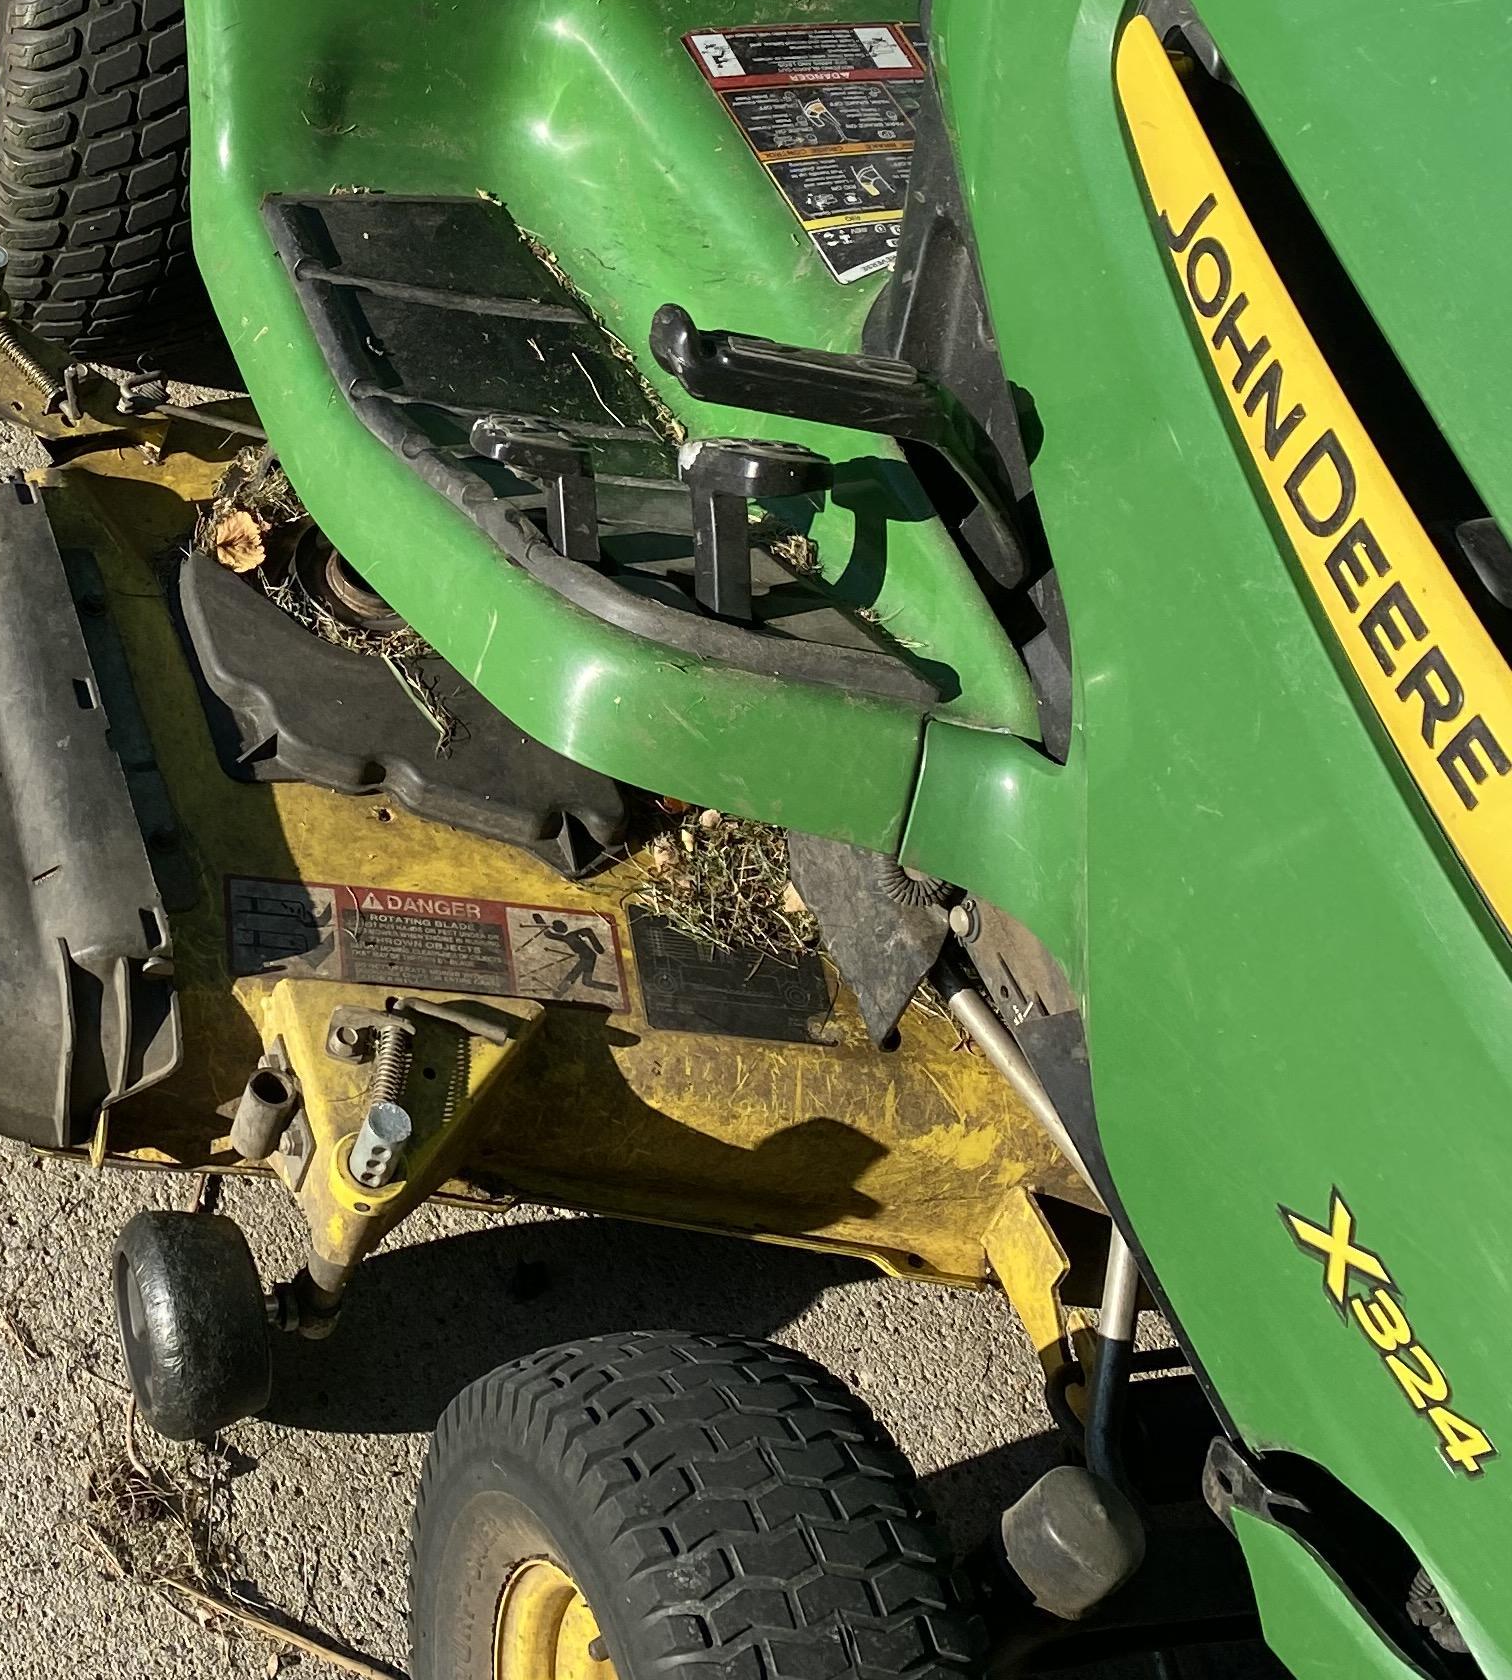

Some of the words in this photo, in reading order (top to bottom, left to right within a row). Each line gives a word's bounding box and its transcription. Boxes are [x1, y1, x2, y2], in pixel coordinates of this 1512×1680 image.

[1160, 193, 1304, 461] JOHN
[1283, 428, 1511, 811] DEERE
[388, 896, 481, 919] DANGER
[370, 914, 431, 926] ROTATING
[434, 921, 476, 931] BLADE
[425, 941, 481, 954] OBJECTS
[1277, 1184, 1496, 1478] X324
